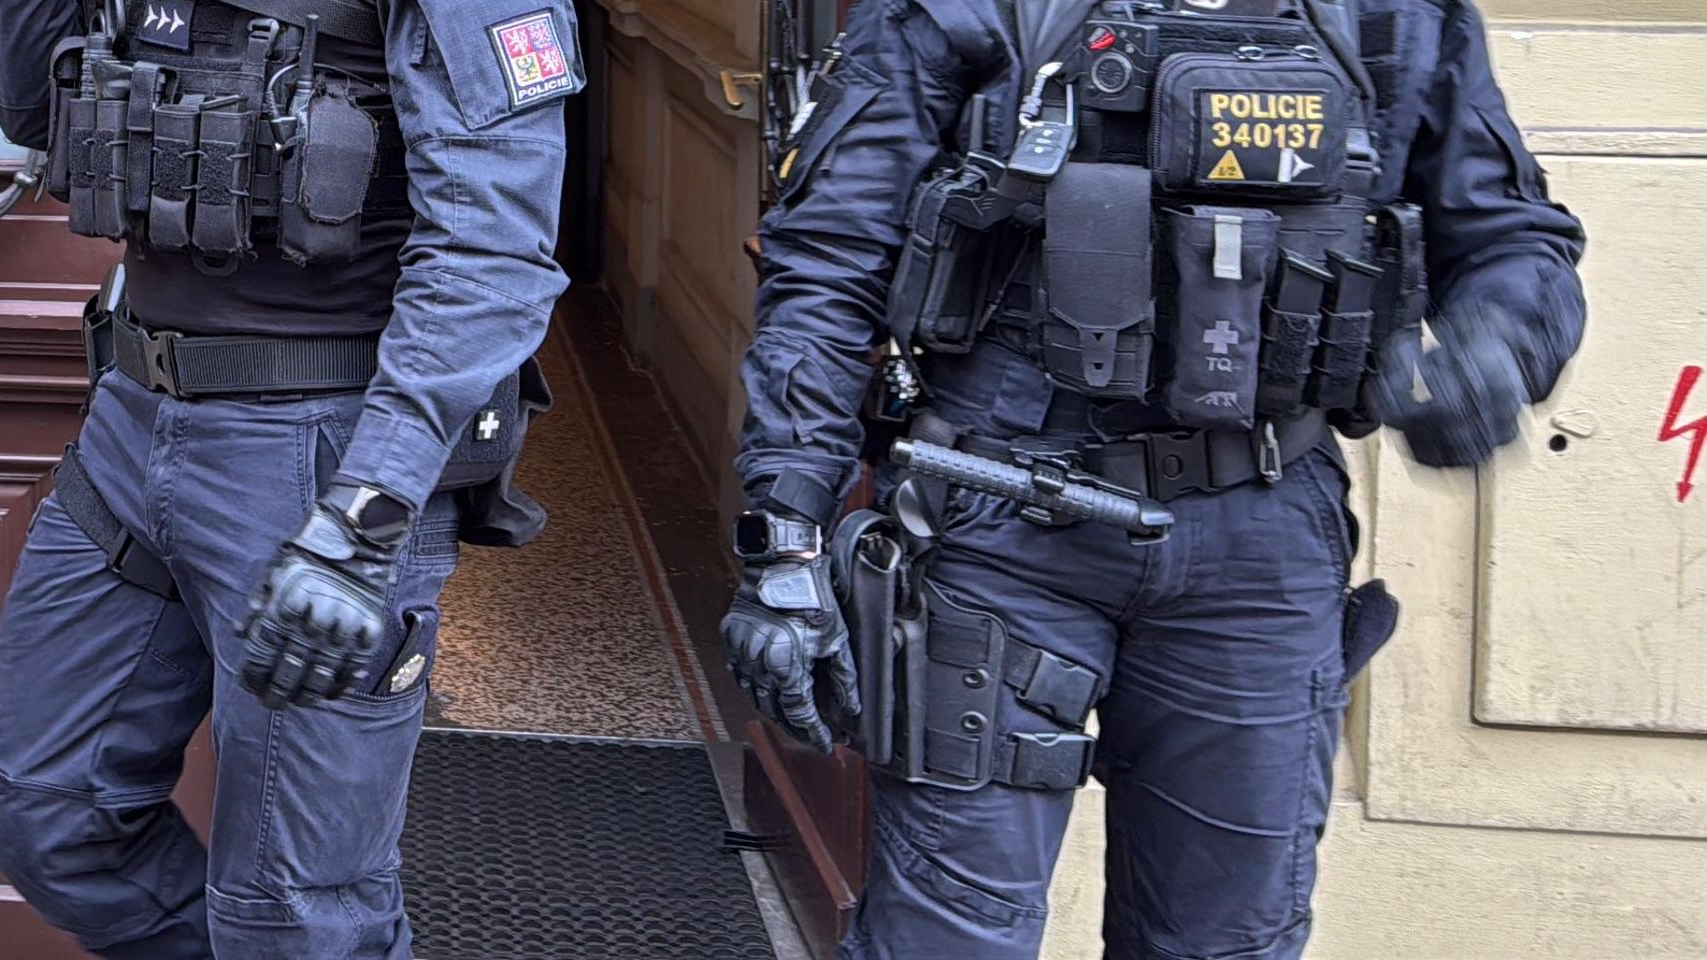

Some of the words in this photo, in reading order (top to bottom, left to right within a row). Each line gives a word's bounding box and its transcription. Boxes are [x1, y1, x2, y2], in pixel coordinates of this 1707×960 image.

[518, 77, 569, 100] POLICIE
[1210, 93, 1324, 120] POLICIE
[1211, 122, 1324, 150] 340137
[1205, 356, 1233, 373] TQ
